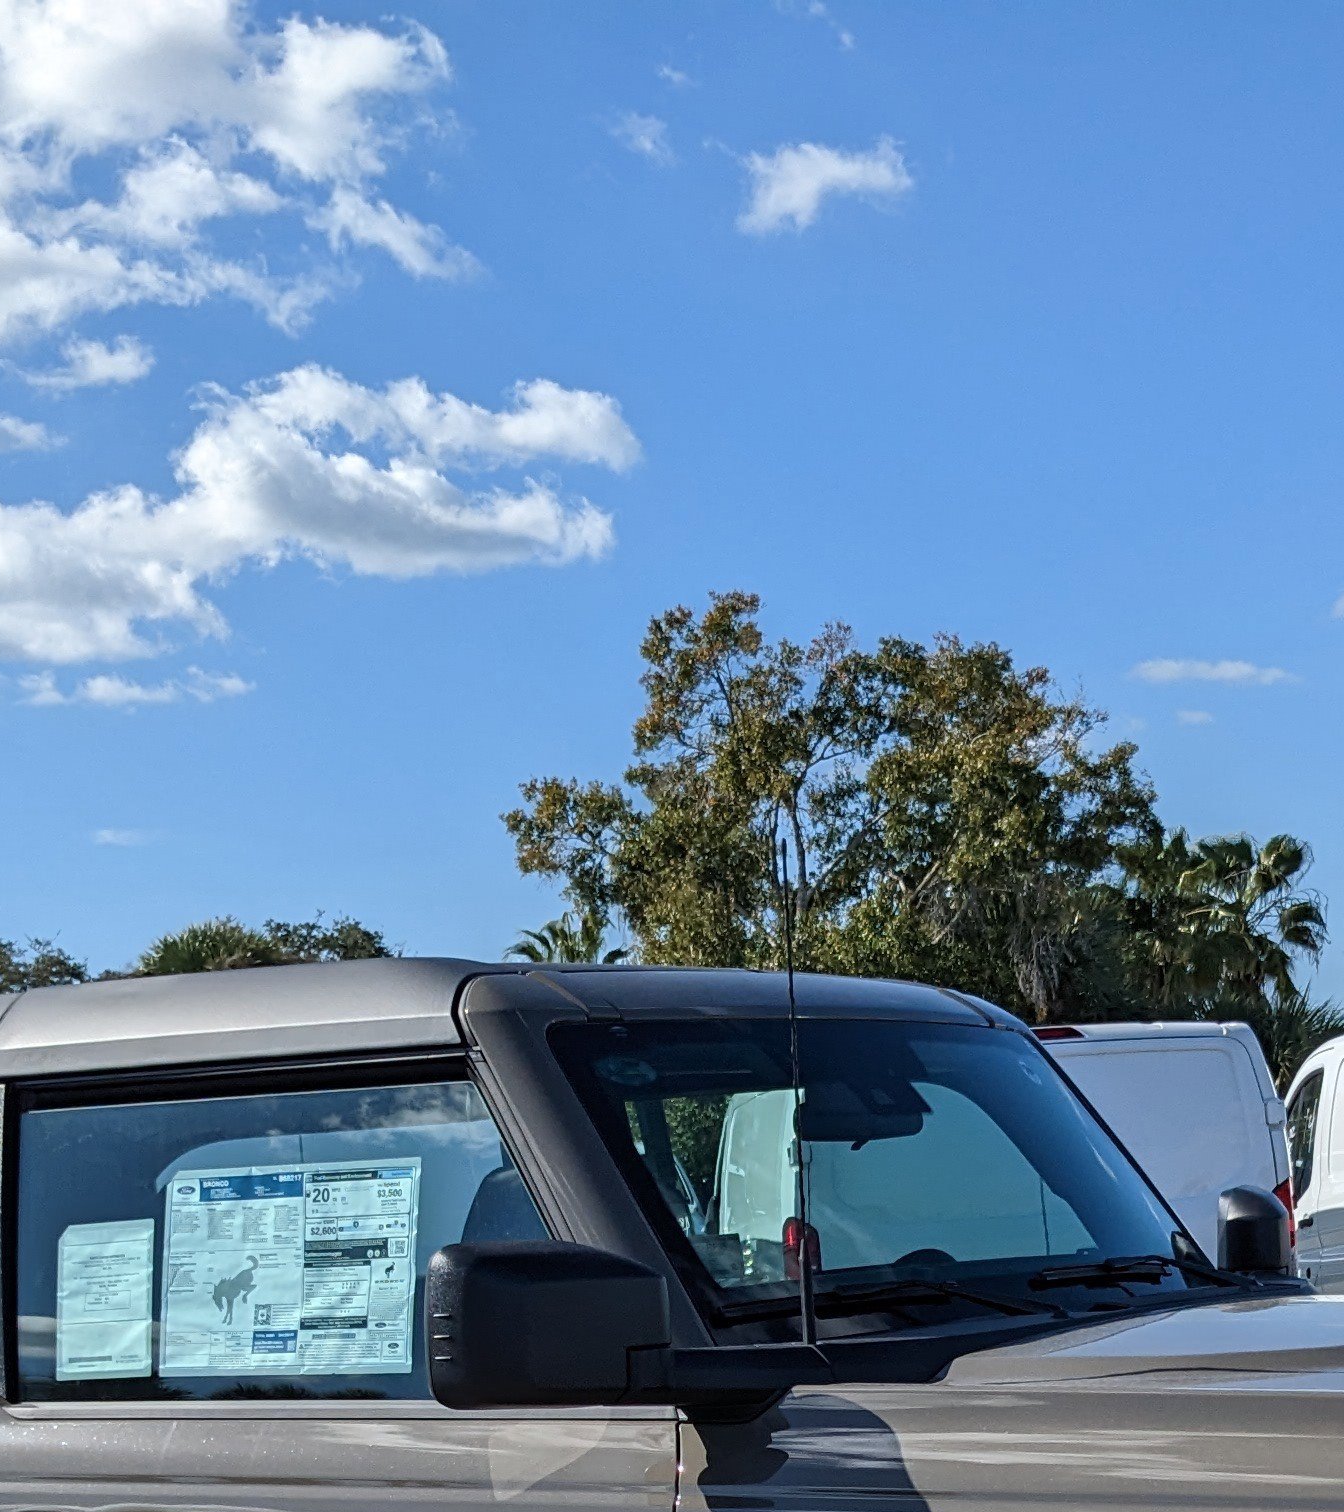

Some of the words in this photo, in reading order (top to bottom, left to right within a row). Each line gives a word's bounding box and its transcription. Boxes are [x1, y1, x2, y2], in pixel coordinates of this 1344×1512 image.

[312, 1187, 330, 1203] 20
[377, 1188, 403, 1199] $3,500
[310, 1226, 337, 1237] $2,600
